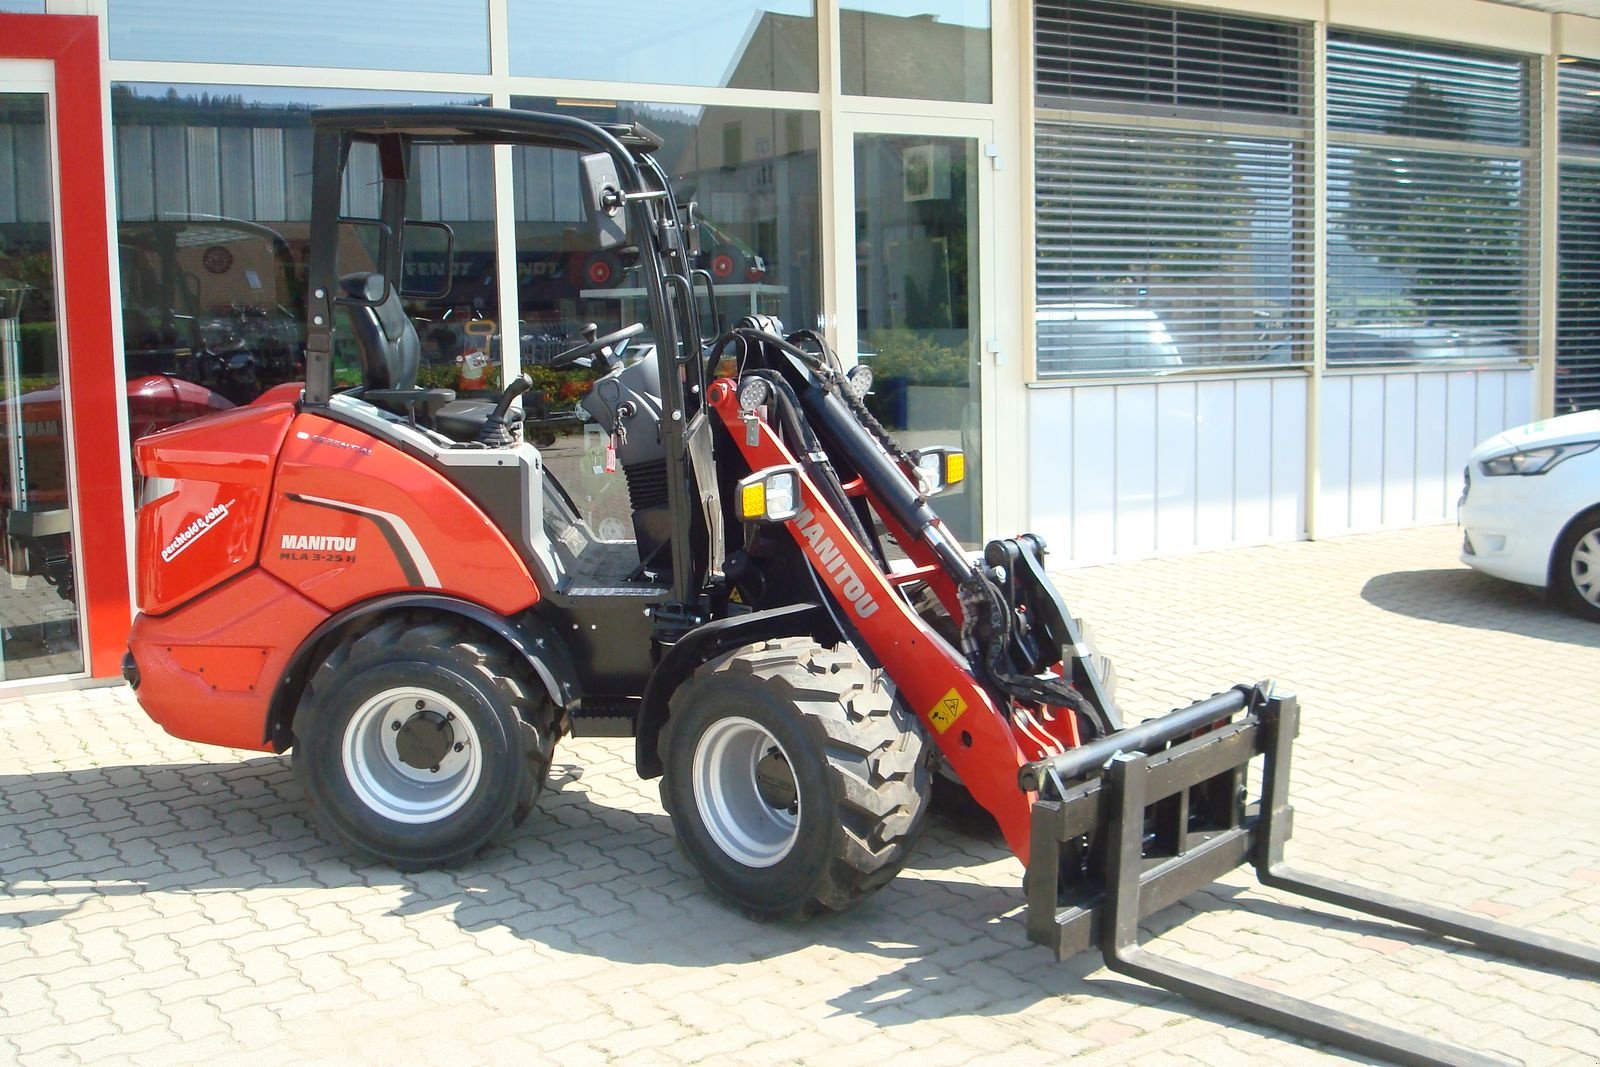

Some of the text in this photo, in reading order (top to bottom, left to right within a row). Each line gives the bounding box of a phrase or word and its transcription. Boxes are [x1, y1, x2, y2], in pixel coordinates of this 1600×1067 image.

[281, 534, 357, 552] MANITOU
[279, 552, 357, 564] MLA 3-25 H
